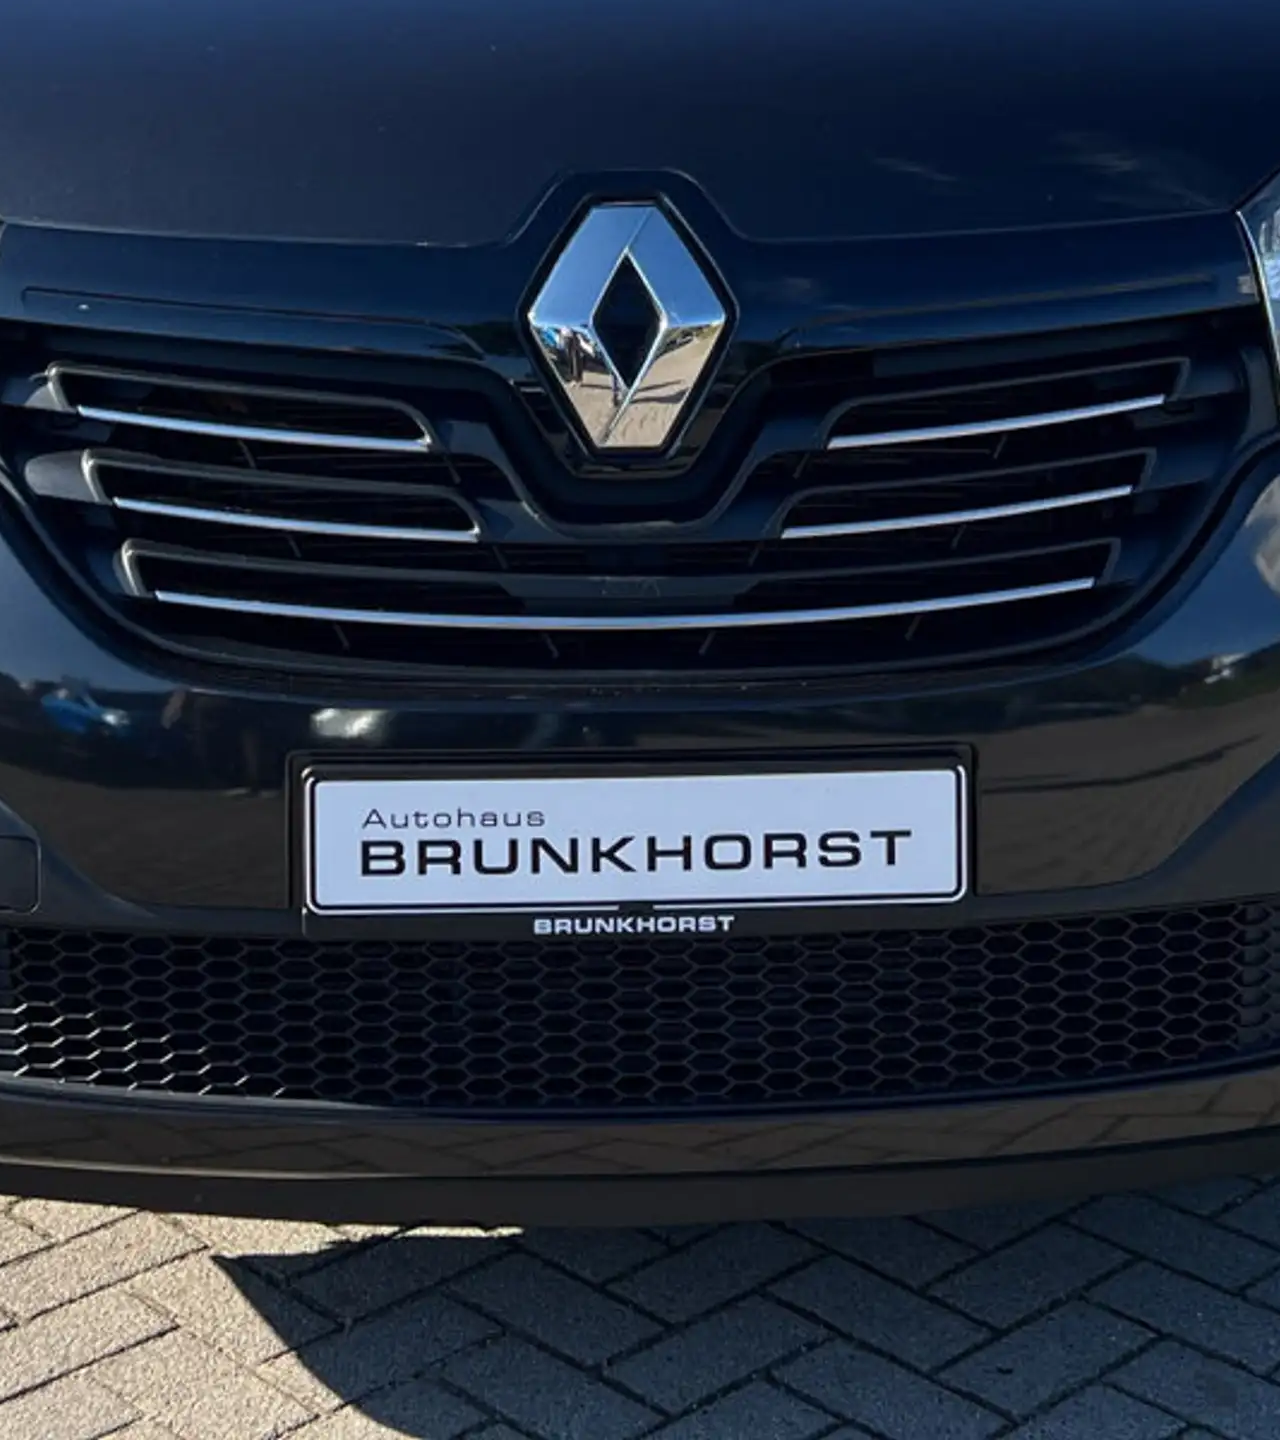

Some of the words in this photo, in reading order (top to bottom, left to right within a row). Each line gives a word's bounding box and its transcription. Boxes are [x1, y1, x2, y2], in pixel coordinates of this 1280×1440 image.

[362, 807, 546, 829] Autohaus
[361, 829, 912, 877] BRUNKHORST
[533, 915, 735, 935] BRUNKHORST
